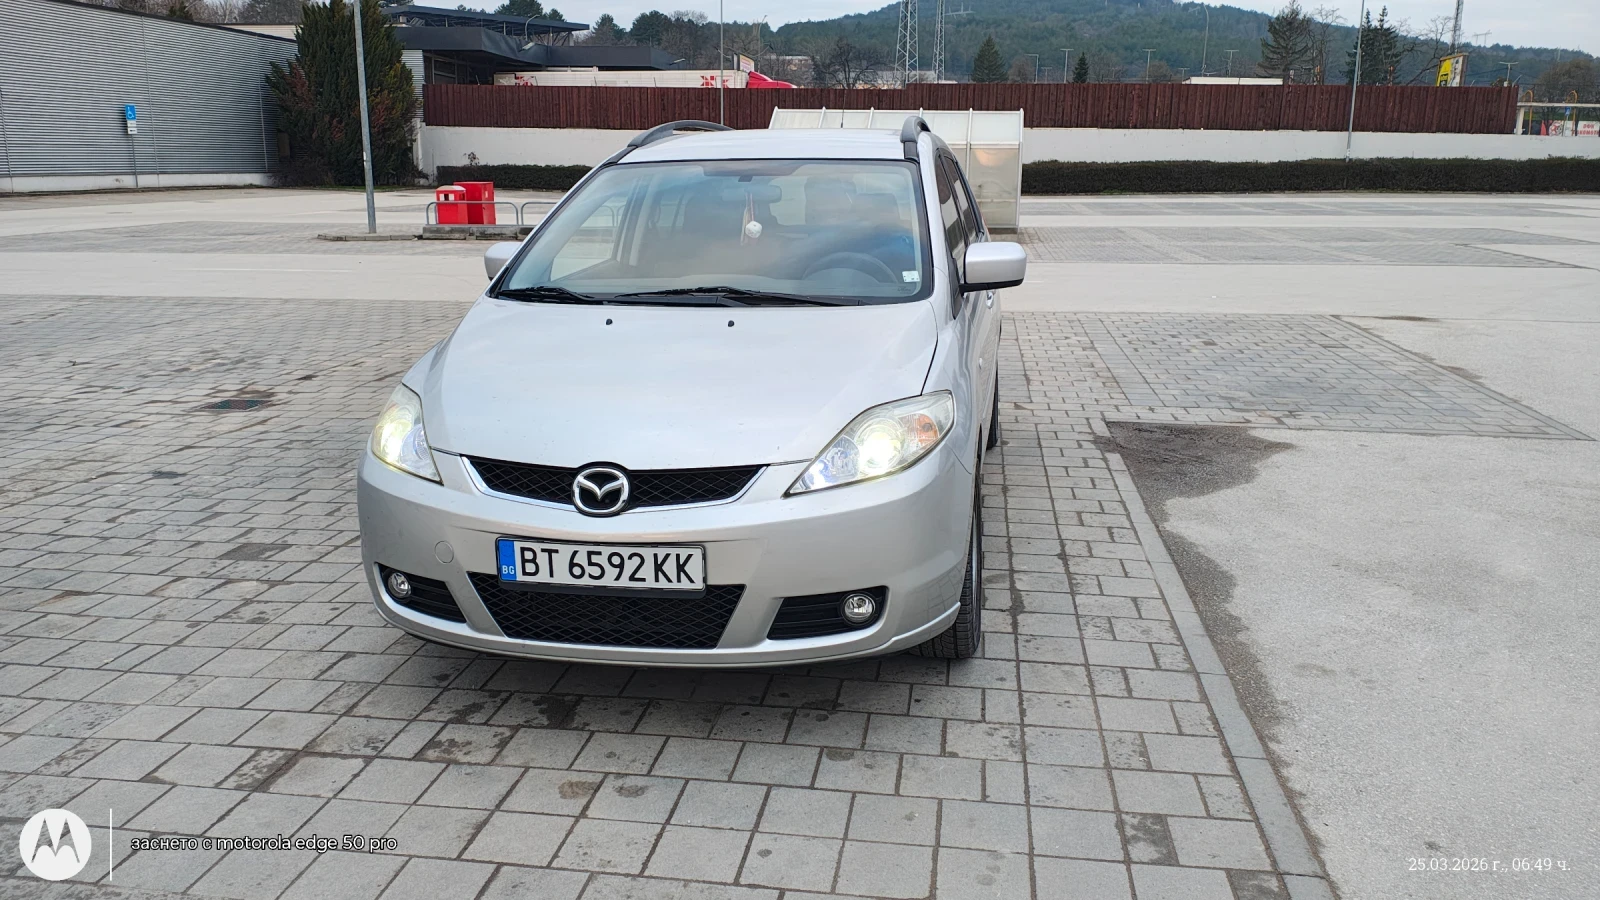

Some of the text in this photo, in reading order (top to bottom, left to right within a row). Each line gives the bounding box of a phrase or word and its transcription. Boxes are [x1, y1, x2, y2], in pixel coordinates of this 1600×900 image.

[502, 565, 515, 575] BG
[520, 546, 696, 584] BT 6592 KK
